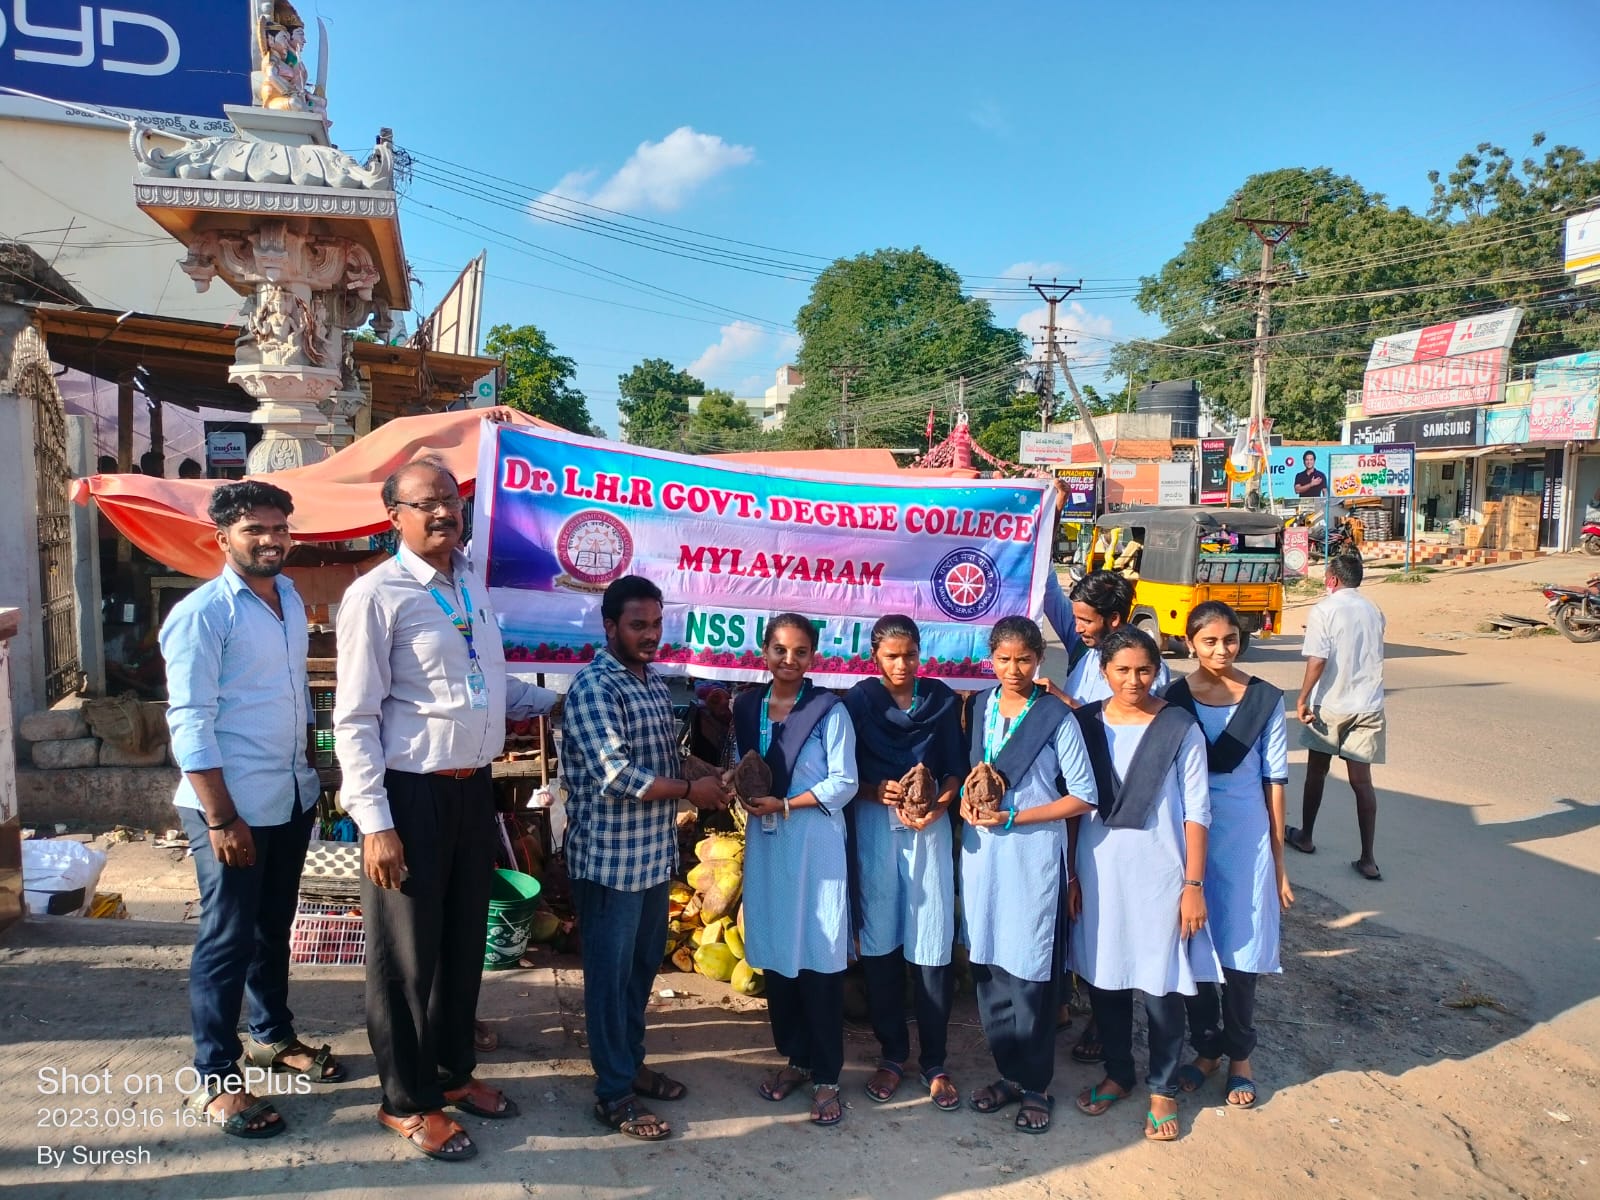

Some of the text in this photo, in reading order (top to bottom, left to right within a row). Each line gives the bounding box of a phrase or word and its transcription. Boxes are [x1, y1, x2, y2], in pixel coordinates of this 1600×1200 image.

[189, 119, 199, 130] &
[1367, 353, 1494, 397] KAMADHENU
[1423, 421, 1471, 438] SAMSUNG
[1058, 469, 1094, 477] KAMADHENU
[504, 458, 1034, 543] Dr. L.H.R GOVT. DEGREE COLLEGE
[1543, 477, 1551, 519] SAMSUNG
[1552, 477, 1562, 520] SAMSUNG
[677, 545, 885, 587] MYLAVARAM
[939, 586, 954, 611] NATIONAL
[955, 606, 976, 614] SERVICE
[685, 611, 745, 648] NSS
